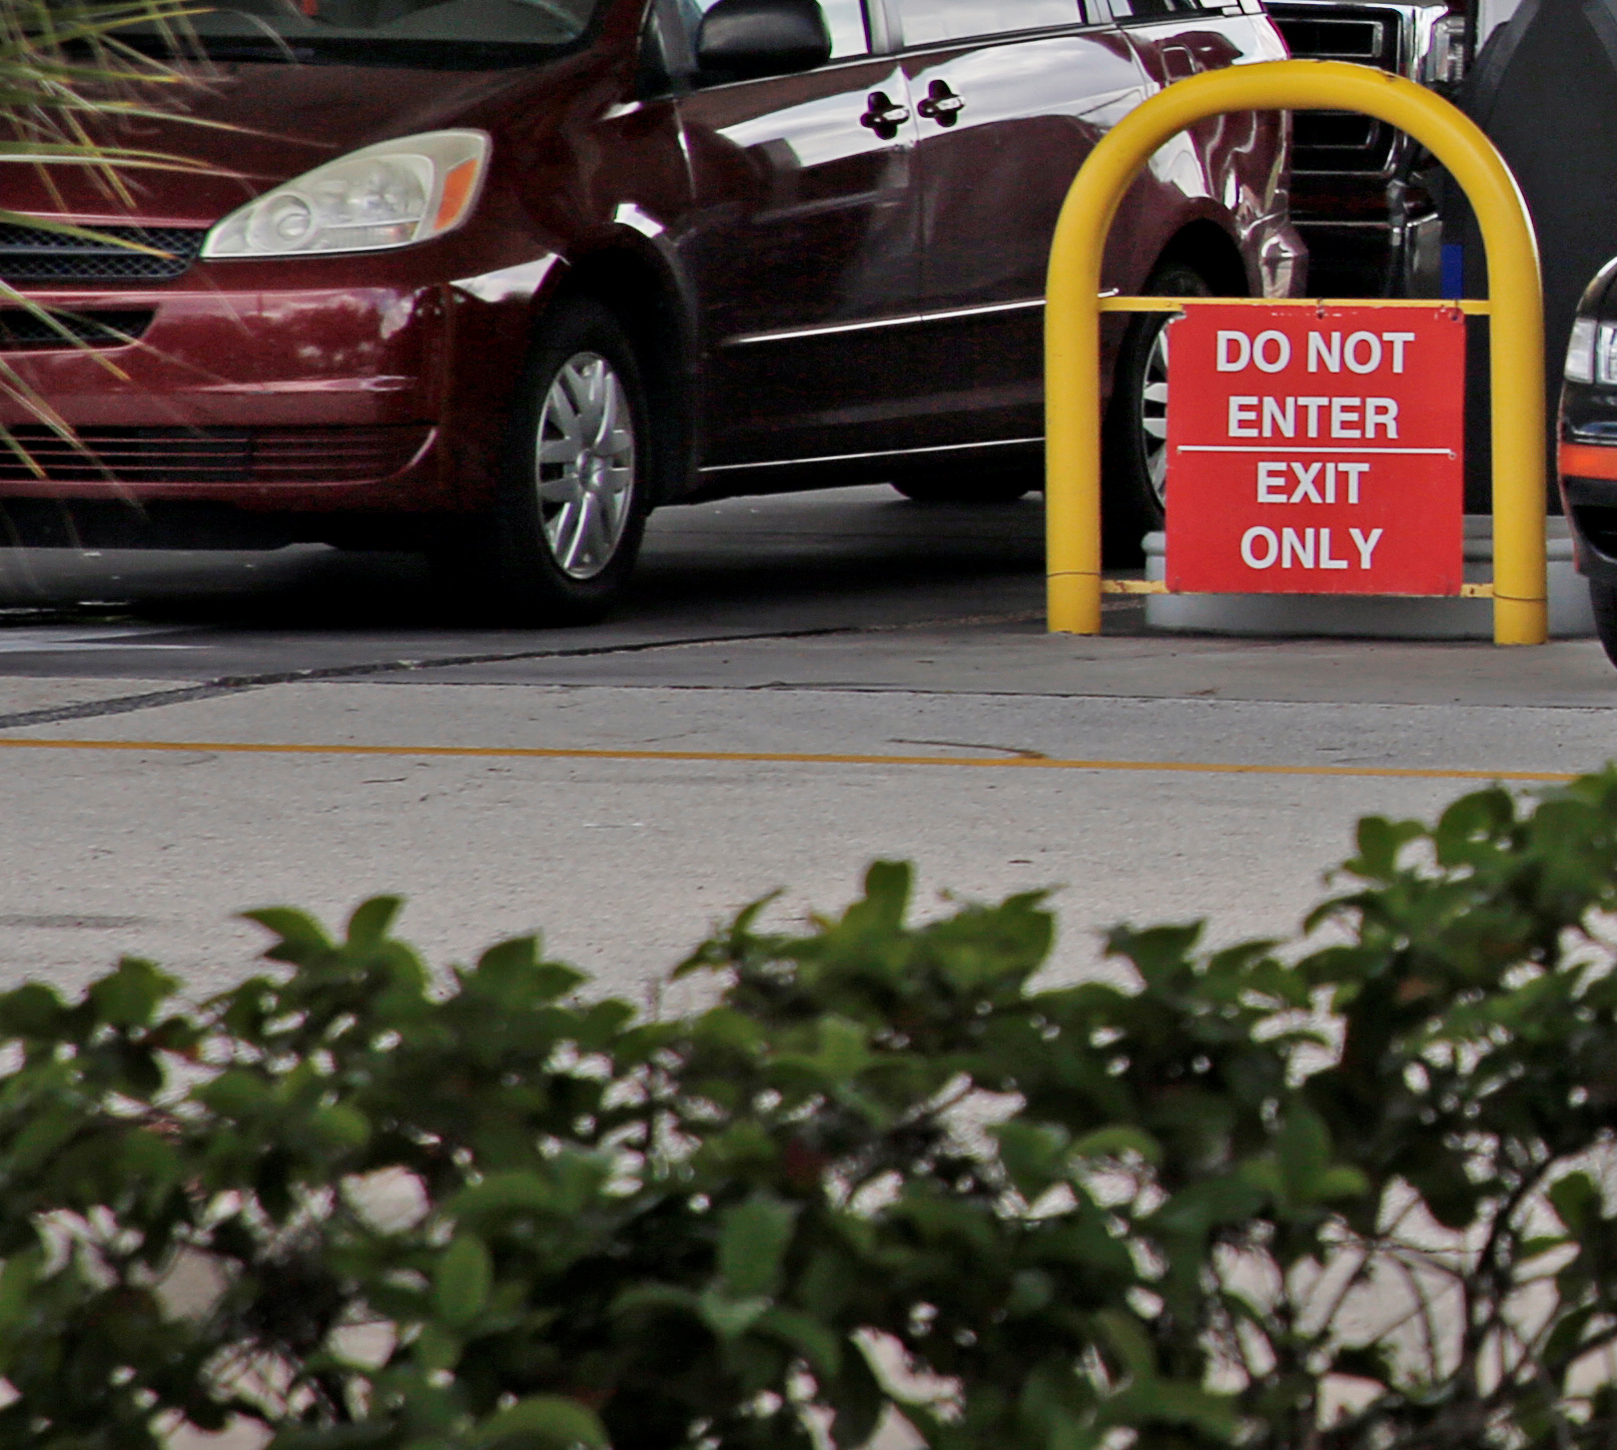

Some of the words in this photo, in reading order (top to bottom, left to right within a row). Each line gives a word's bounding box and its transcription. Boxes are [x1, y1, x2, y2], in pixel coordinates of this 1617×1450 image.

[1216, 330, 1291, 374] DO
[1307, 330, 1415, 374] NOT
[1227, 396, 1398, 440] ENTER
[1257, 461, 1371, 504] EXIT
[1240, 526, 1384, 570] ONLY
